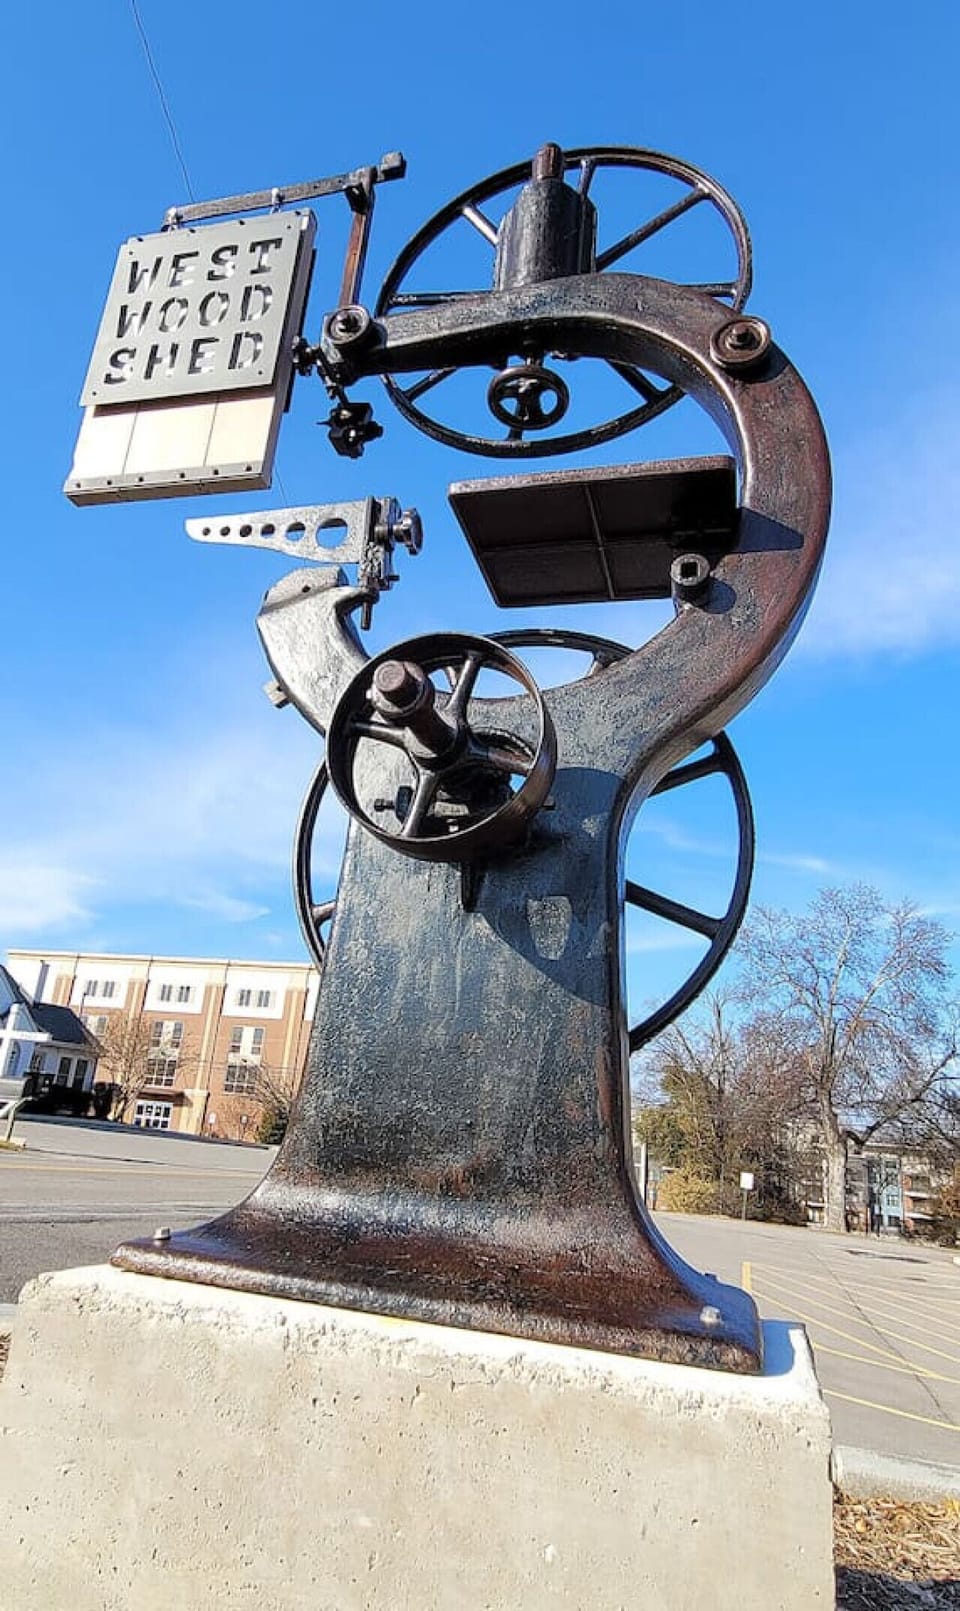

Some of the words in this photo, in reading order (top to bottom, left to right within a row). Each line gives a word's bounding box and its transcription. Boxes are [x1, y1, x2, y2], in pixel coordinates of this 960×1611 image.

[127, 238, 283, 294] WEST
[116, 284, 273, 338] WOOD
[104, 332, 263, 385] SHED
